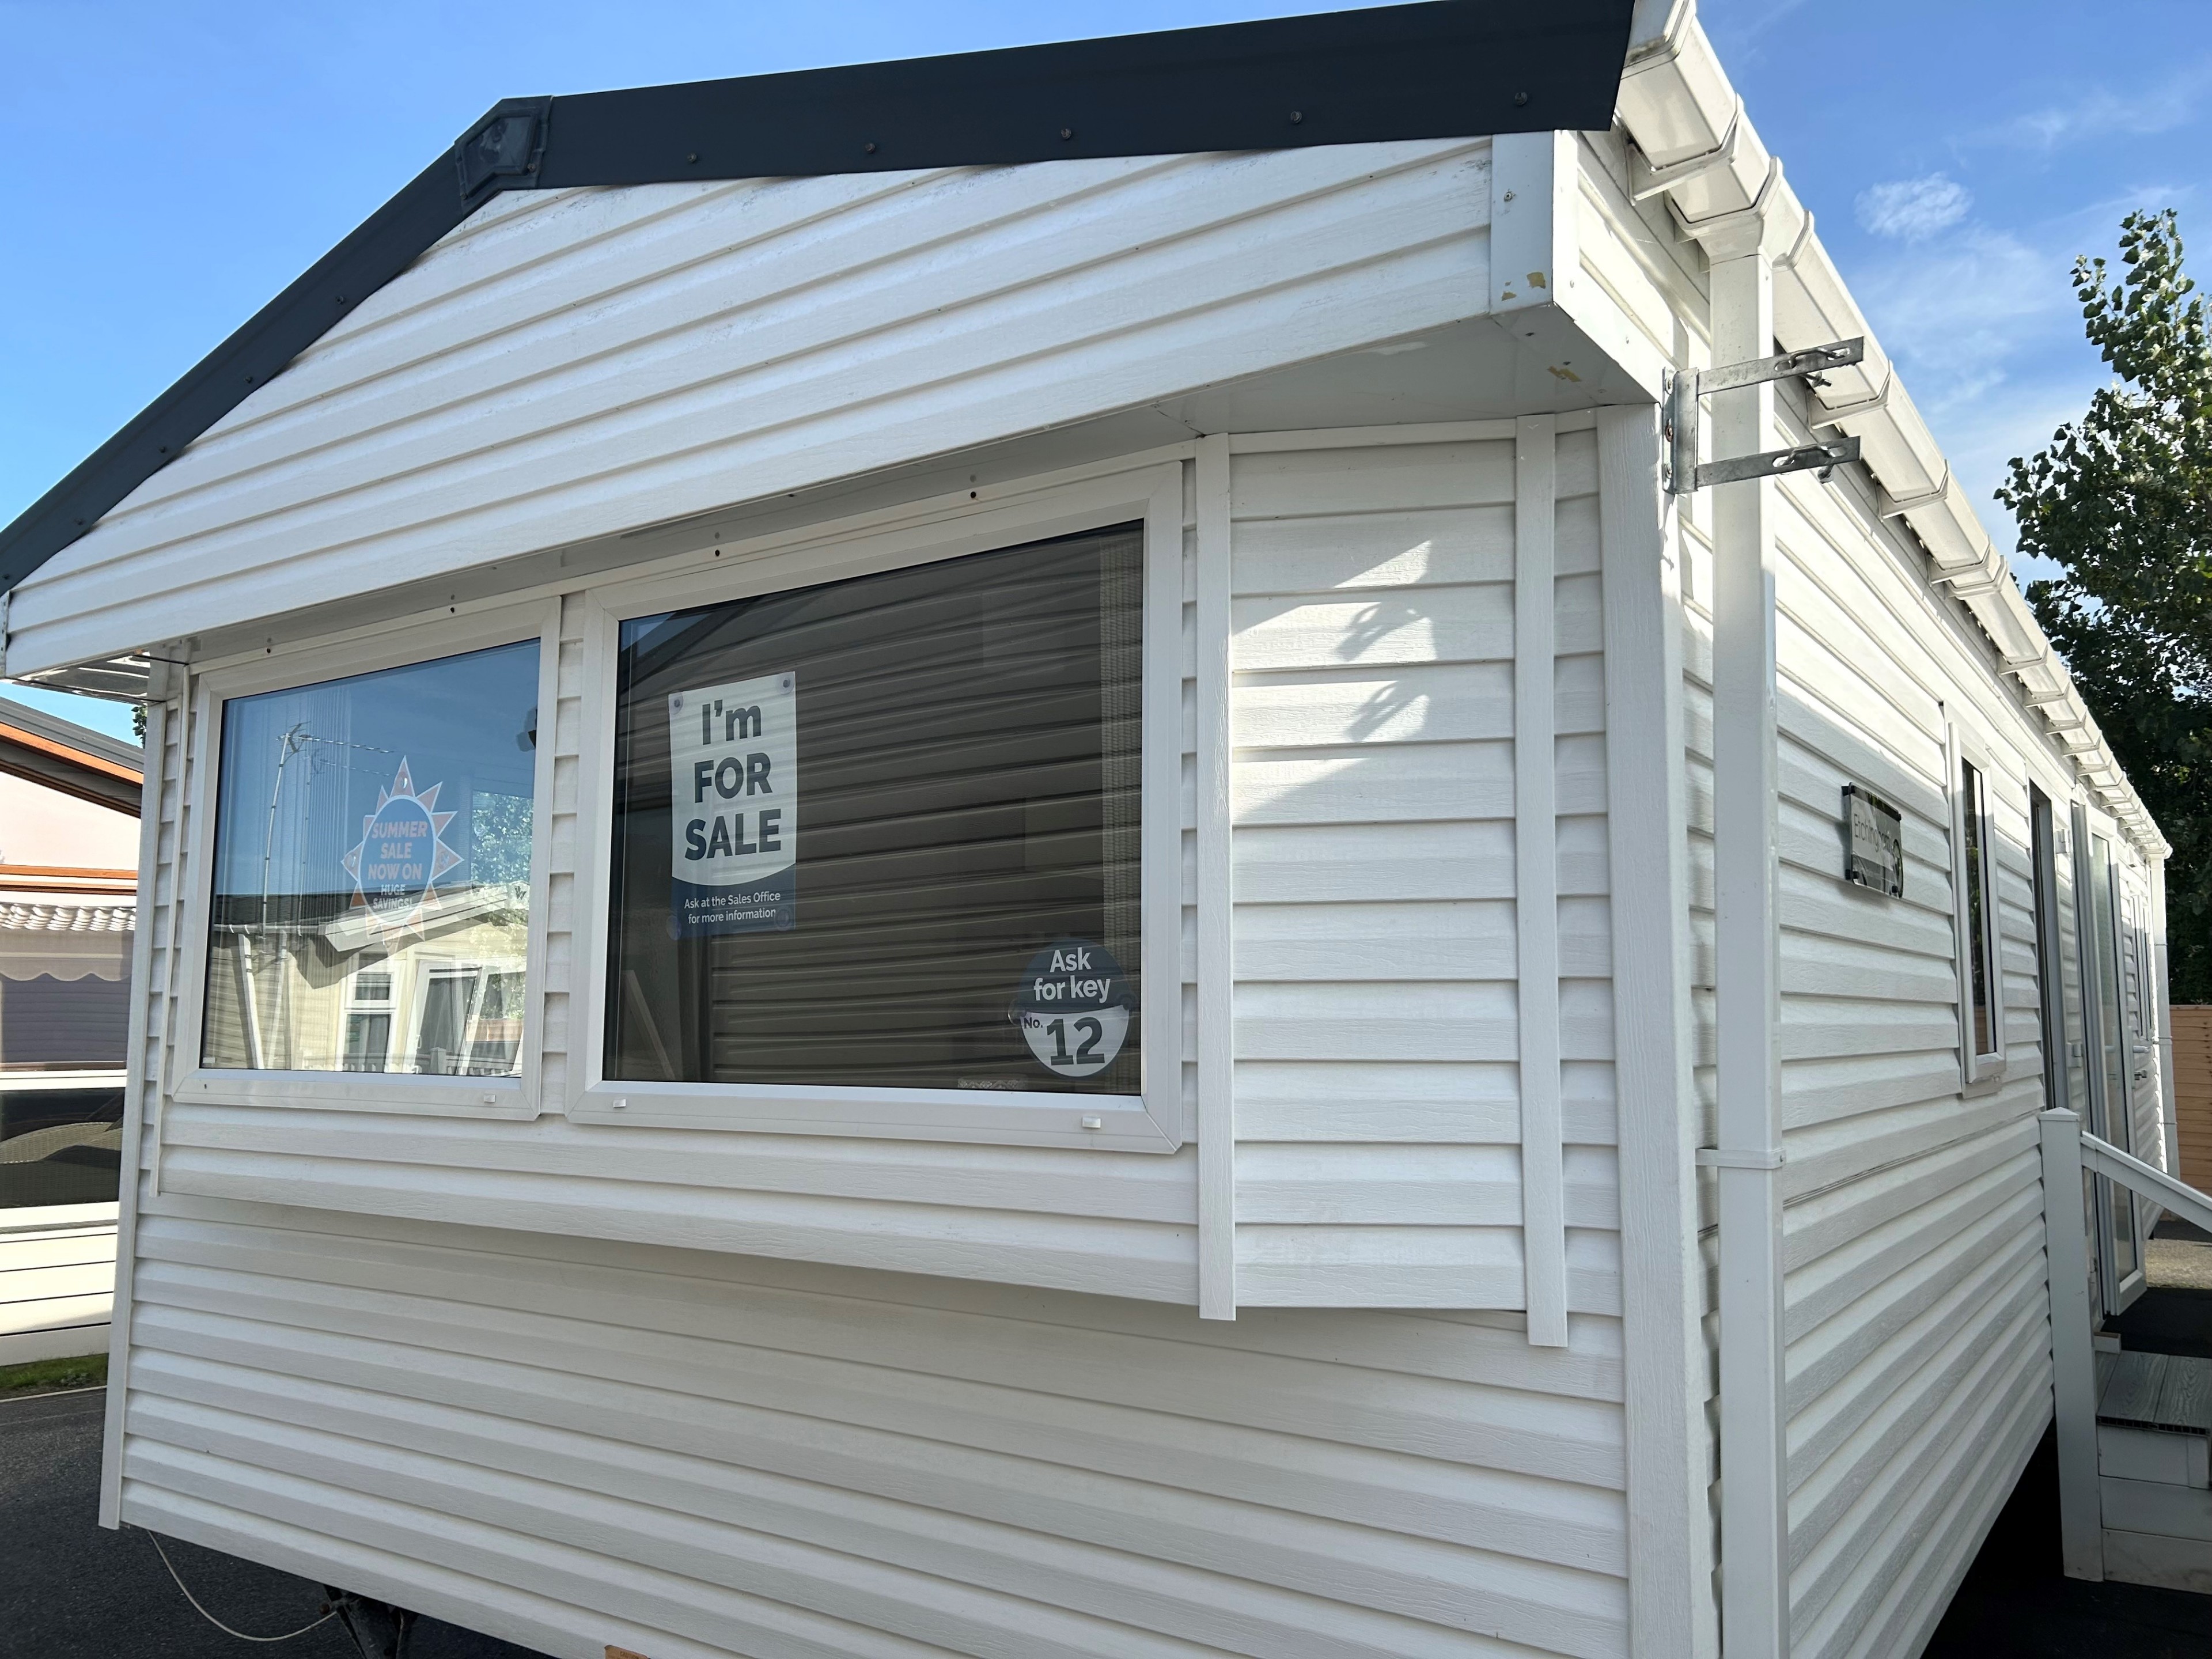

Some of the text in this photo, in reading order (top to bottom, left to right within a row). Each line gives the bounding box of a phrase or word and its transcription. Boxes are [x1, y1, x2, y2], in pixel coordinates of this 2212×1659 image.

[702, 699, 762, 745] I'm
[694, 752, 772, 804] FOR
[372, 820, 427, 839] SUMMER
[684, 808, 781, 861] SALE
[380, 842, 412, 859] SALE
[368, 863, 422, 880] NOW ON
[381, 884, 406, 896] HUGE
[684, 891, 781, 908] Ask at the Sales Office
[373, 898, 412, 910] SAVINGS!
[688, 908, 776, 924] for more information
[1050, 947, 1091, 973] Ask
[1033, 975, 1111, 1003] for key
[1023, 1016, 1105, 1066] No. 12
